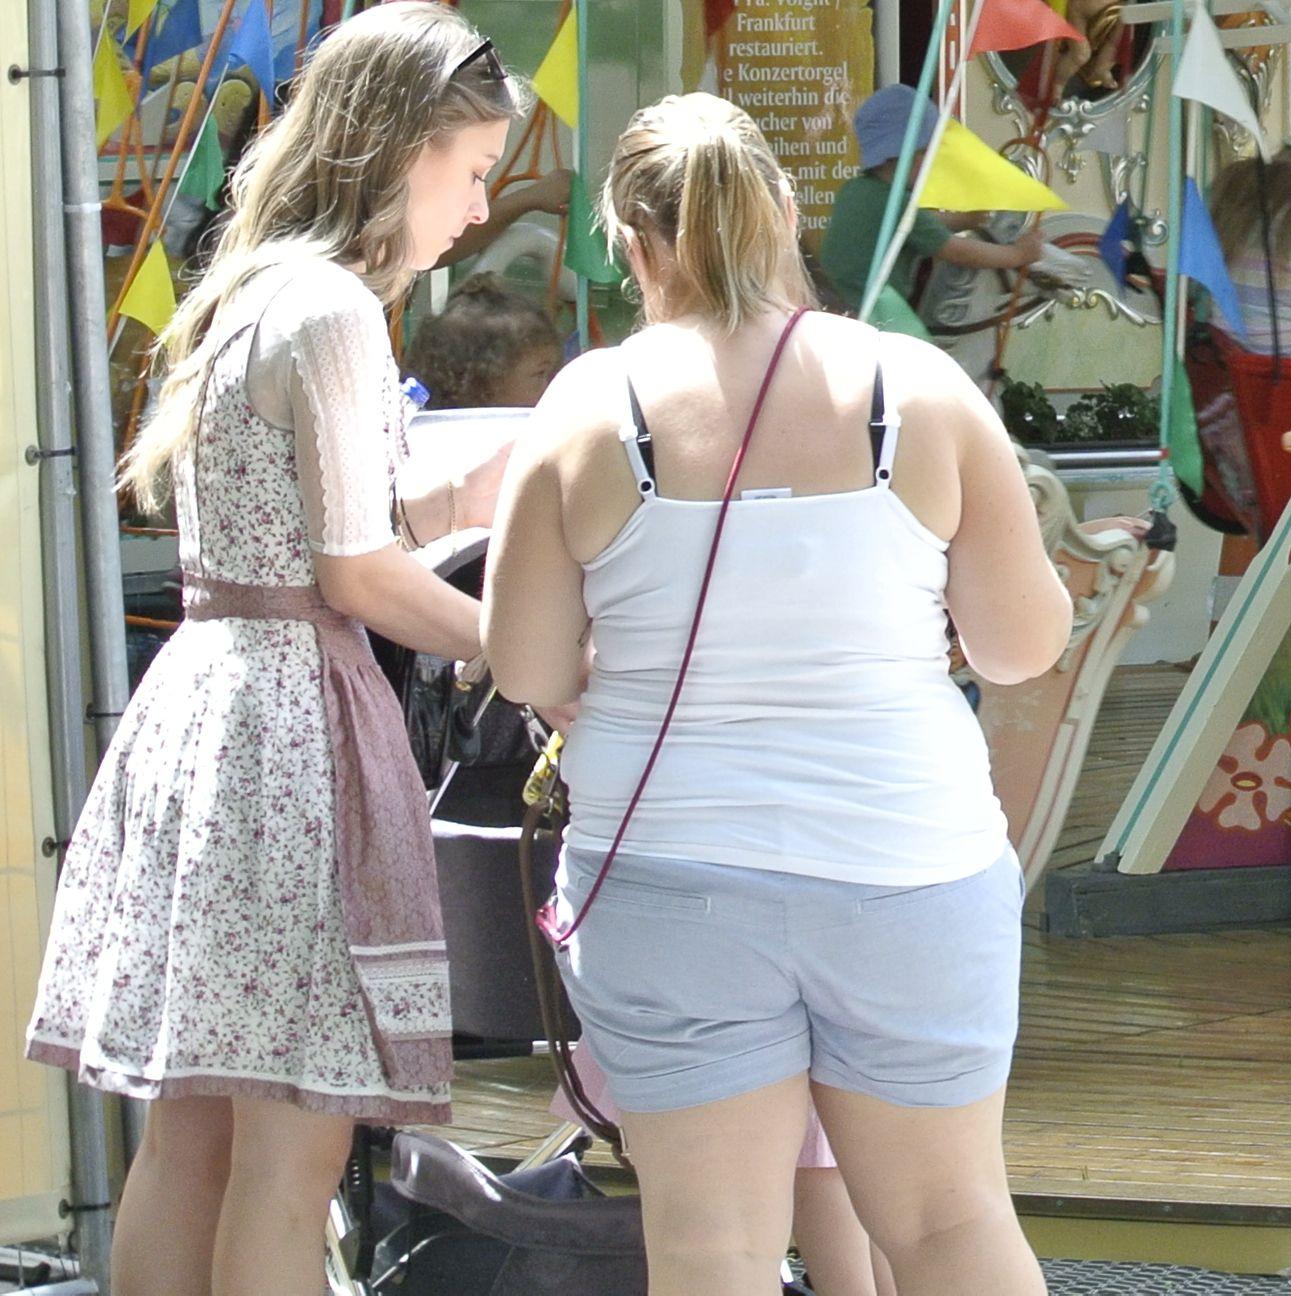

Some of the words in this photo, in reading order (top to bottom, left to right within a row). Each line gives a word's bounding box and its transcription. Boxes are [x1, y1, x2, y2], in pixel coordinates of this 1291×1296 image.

[737, 12, 816, 32] Frankfurt
[728, 38, 823, 57] restauriert.
[738, 61, 848, 85] Konzertorgel
[738, 86, 819, 106] weiterhin
[801, 115, 833, 131] von
[816, 136, 848, 155] und
[798, 161, 826, 180] mit
[832, 160, 861, 180] der
